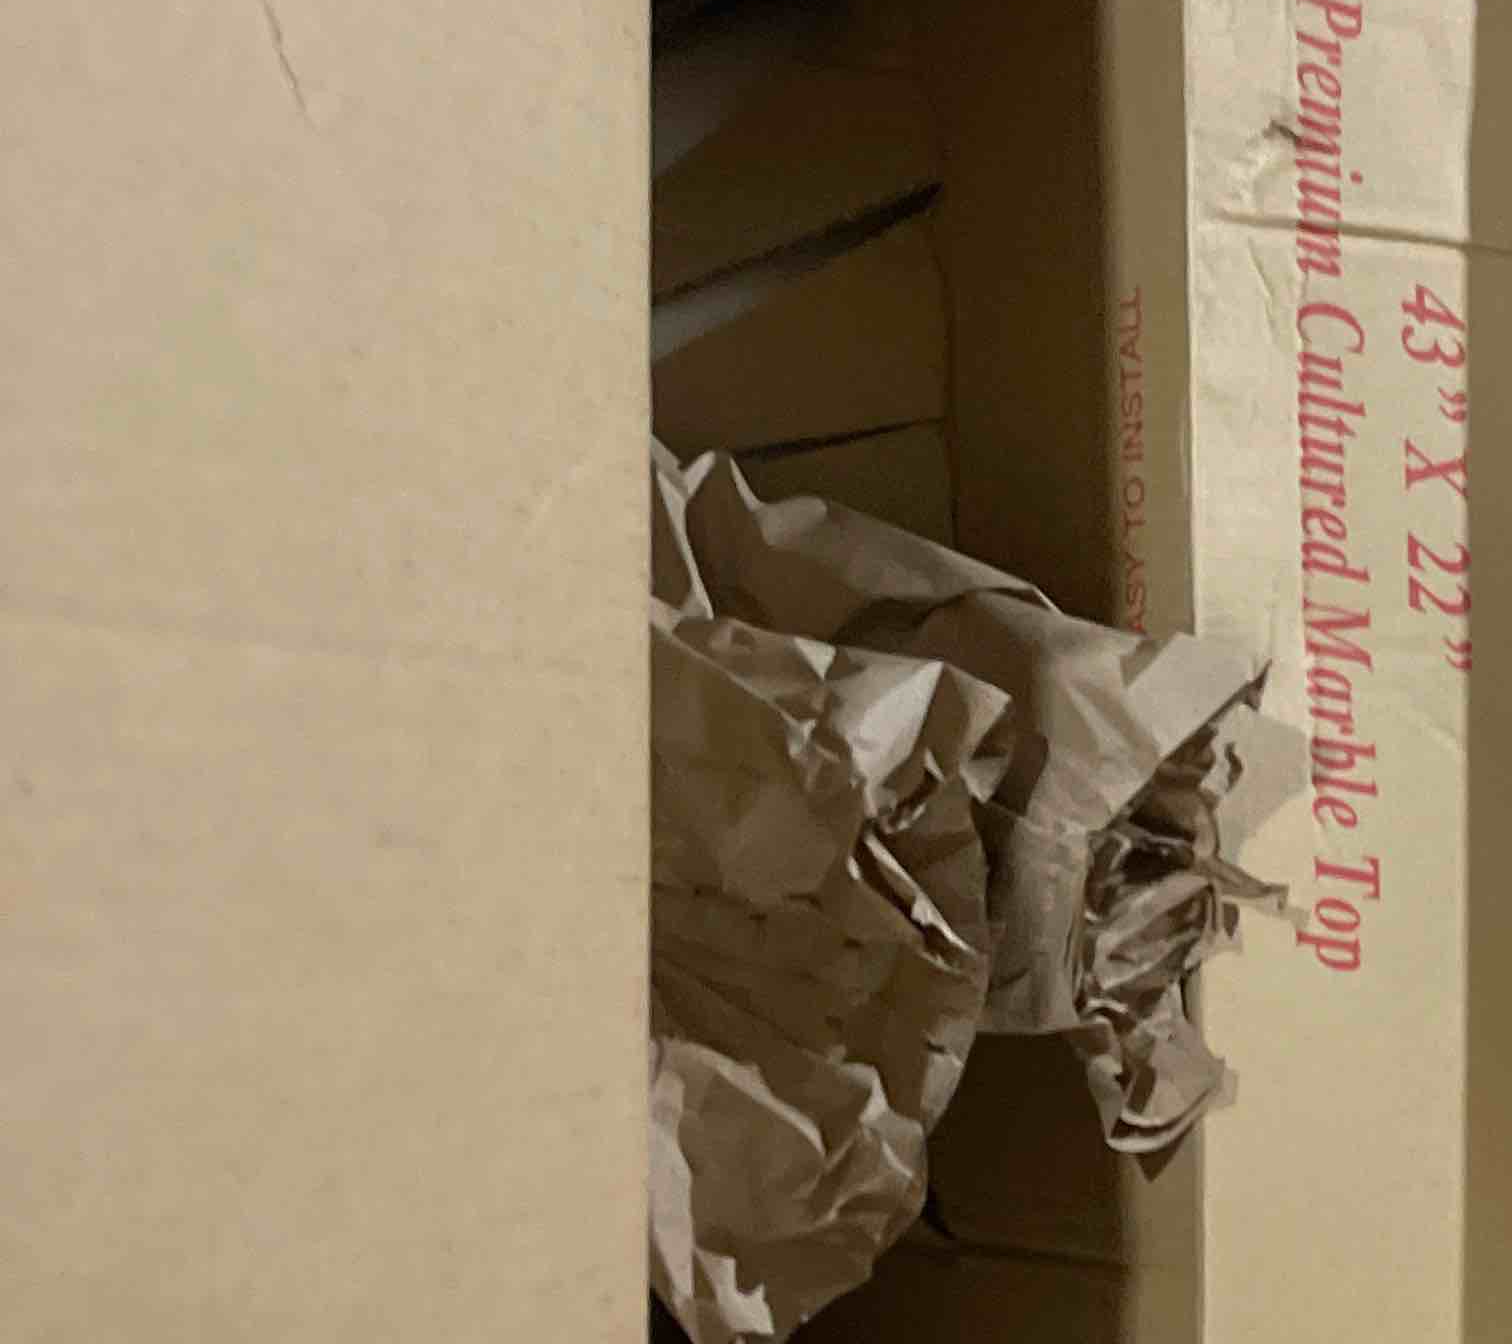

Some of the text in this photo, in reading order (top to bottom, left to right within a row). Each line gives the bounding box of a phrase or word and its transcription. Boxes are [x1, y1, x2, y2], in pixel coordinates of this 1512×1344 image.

[1119, 284, 1148, 634] ASY TO INSTALL
[1296, 301, 1371, 585] Cultured
[1403, 437, 1470, 498] X
[1301, 596, 1379, 829] Marble
[1296, 855, 1381, 973] Top
